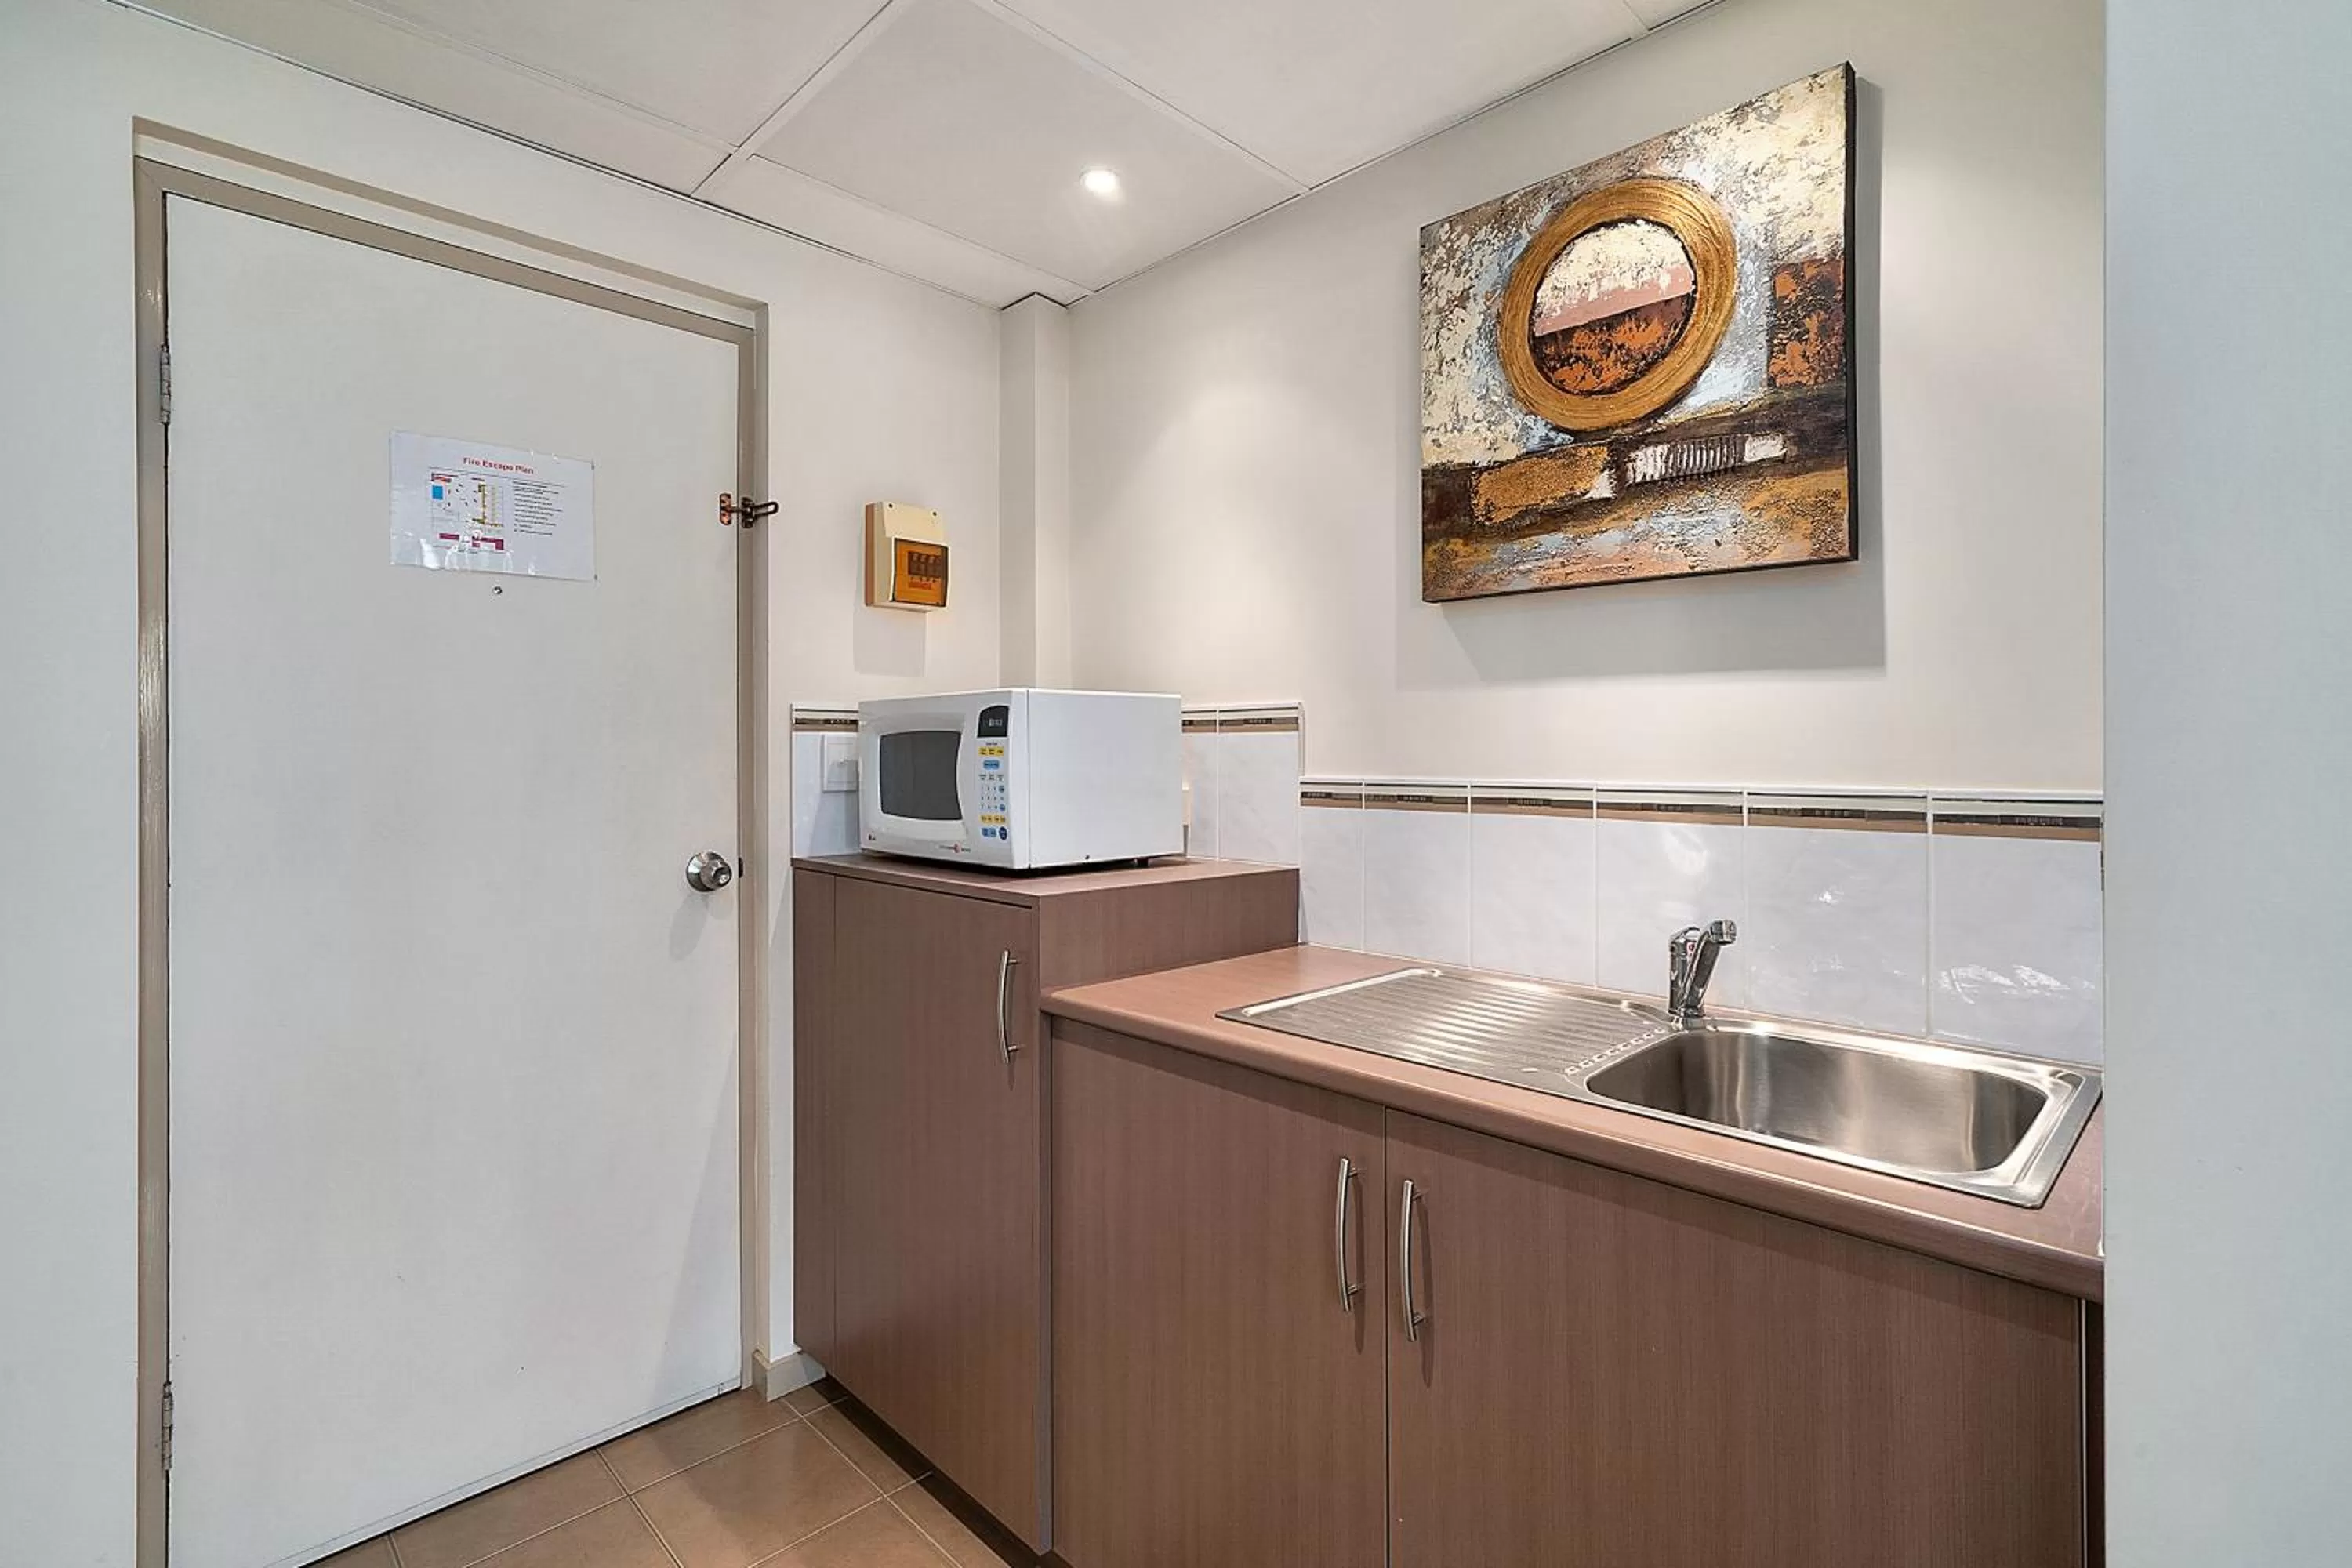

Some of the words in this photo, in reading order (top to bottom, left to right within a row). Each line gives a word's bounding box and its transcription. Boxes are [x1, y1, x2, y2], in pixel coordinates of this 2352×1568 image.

[463, 457, 480, 466] Fire
[482, 460, 513, 470] Escape
[515, 465, 534, 474] Plan
